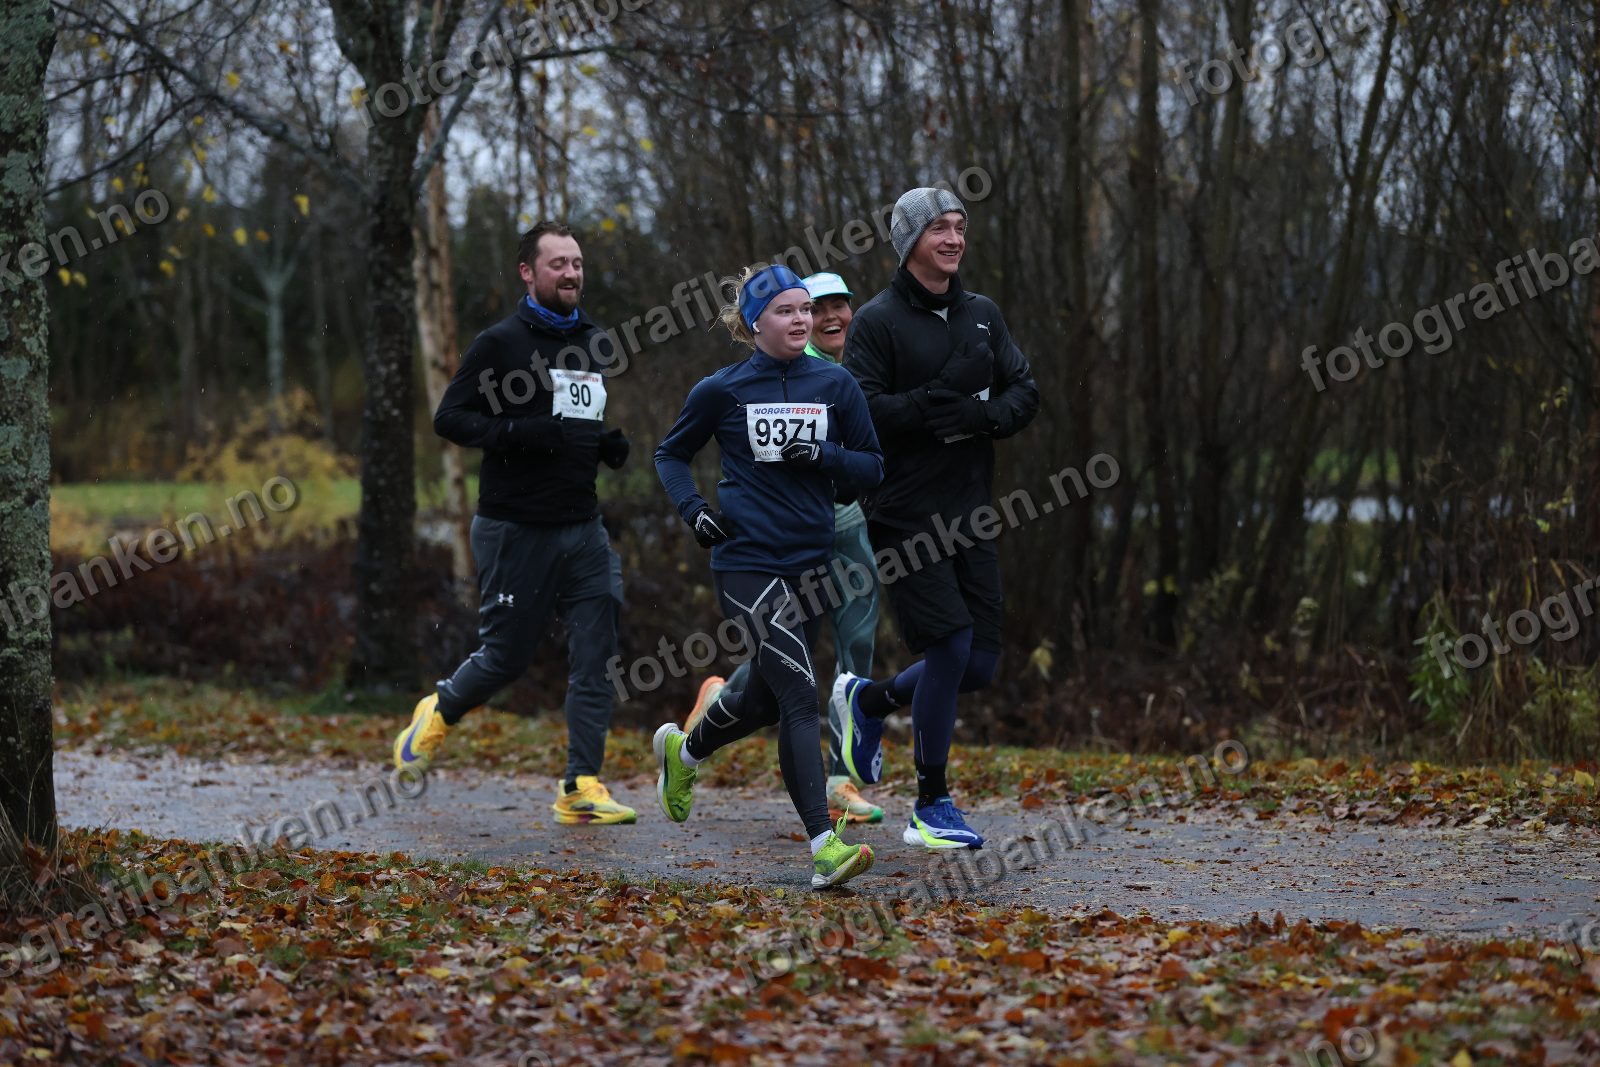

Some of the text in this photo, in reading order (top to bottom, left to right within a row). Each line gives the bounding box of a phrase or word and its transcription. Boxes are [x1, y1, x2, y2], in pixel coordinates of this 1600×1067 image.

[570, 383, 591, 407] 90
[754, 407, 822, 415] NORGESTESTEN
[755, 418, 816, 447] 9371
